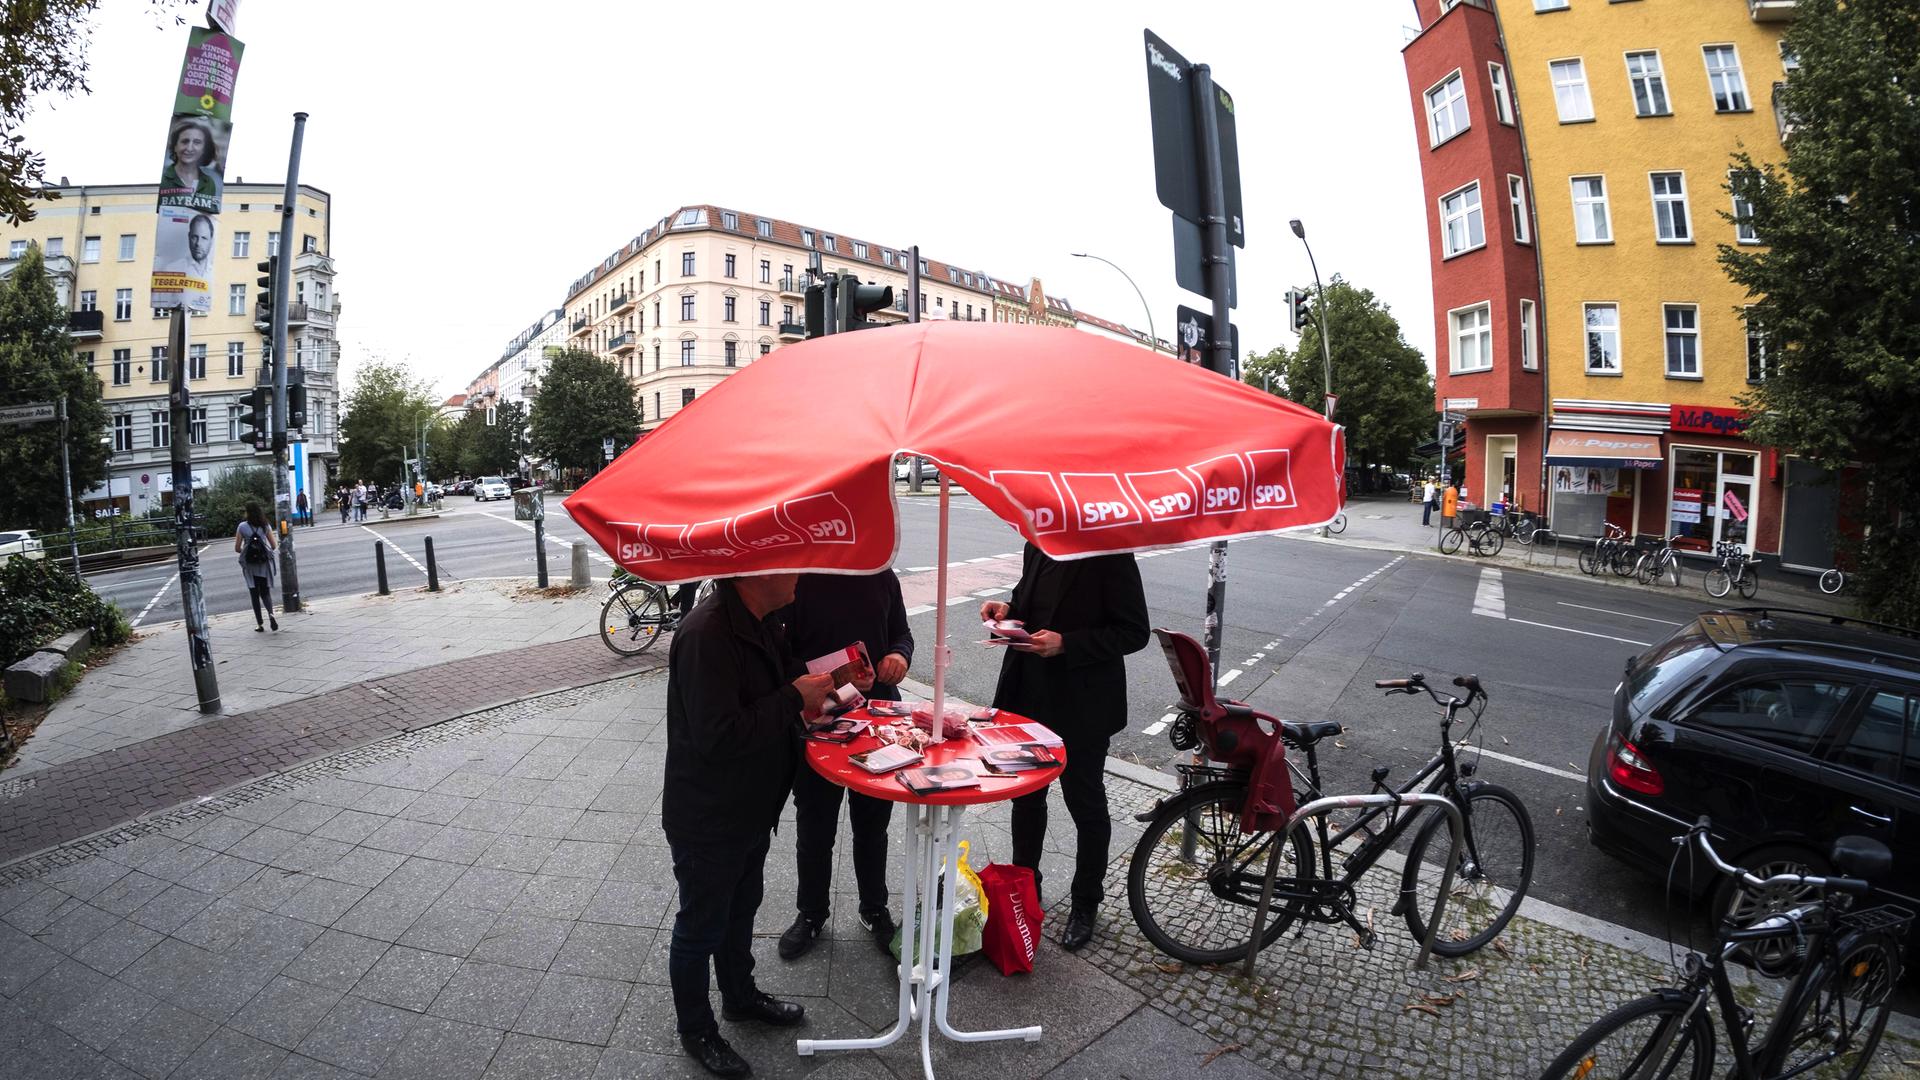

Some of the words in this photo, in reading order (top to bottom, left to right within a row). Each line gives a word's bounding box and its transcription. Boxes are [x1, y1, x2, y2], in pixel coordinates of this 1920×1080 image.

[202, 51, 229, 64] ARMUT
[161, 196, 211, 208] BAYRAM
[1556, 437, 1655, 449] McPaper
[1624, 460, 1656, 469] McPaper
[1083, 501, 1129, 523] SPD
[1148, 492, 1191, 515] SPD
[1206, 486, 1241, 508] SPD
[1255, 484, 1287, 504] SPD
[622, 542, 654, 560] SPD
[750, 533, 791, 547] SPD
[808, 519, 847, 537] SPD
[1009, 892, 1035, 963] Dussmann
